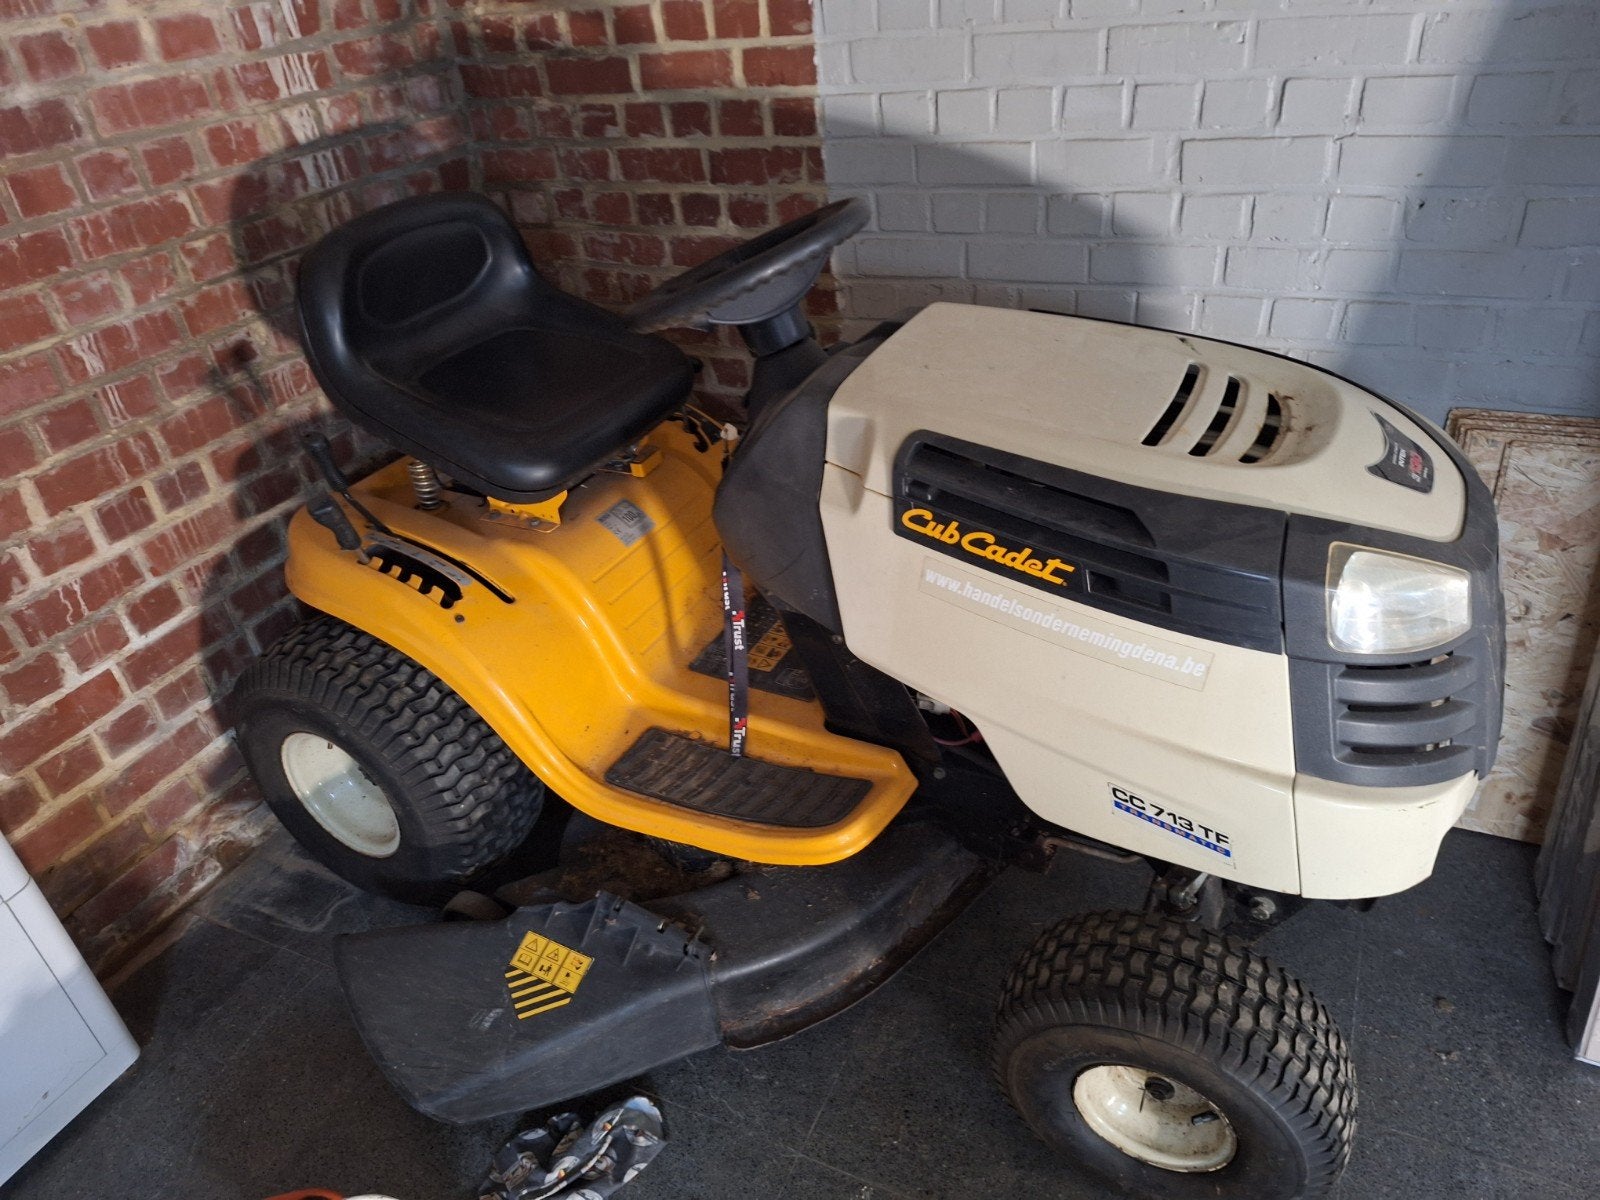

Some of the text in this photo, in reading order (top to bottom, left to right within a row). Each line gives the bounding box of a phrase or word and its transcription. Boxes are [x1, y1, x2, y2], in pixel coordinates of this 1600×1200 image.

[901, 508, 1075, 586] Cub Cadet
[732, 618, 745, 651] Trust
[924, 567, 1207, 679] www.handelsondernemingdena.be
[1111, 787, 1230, 845] CC 713 TF
